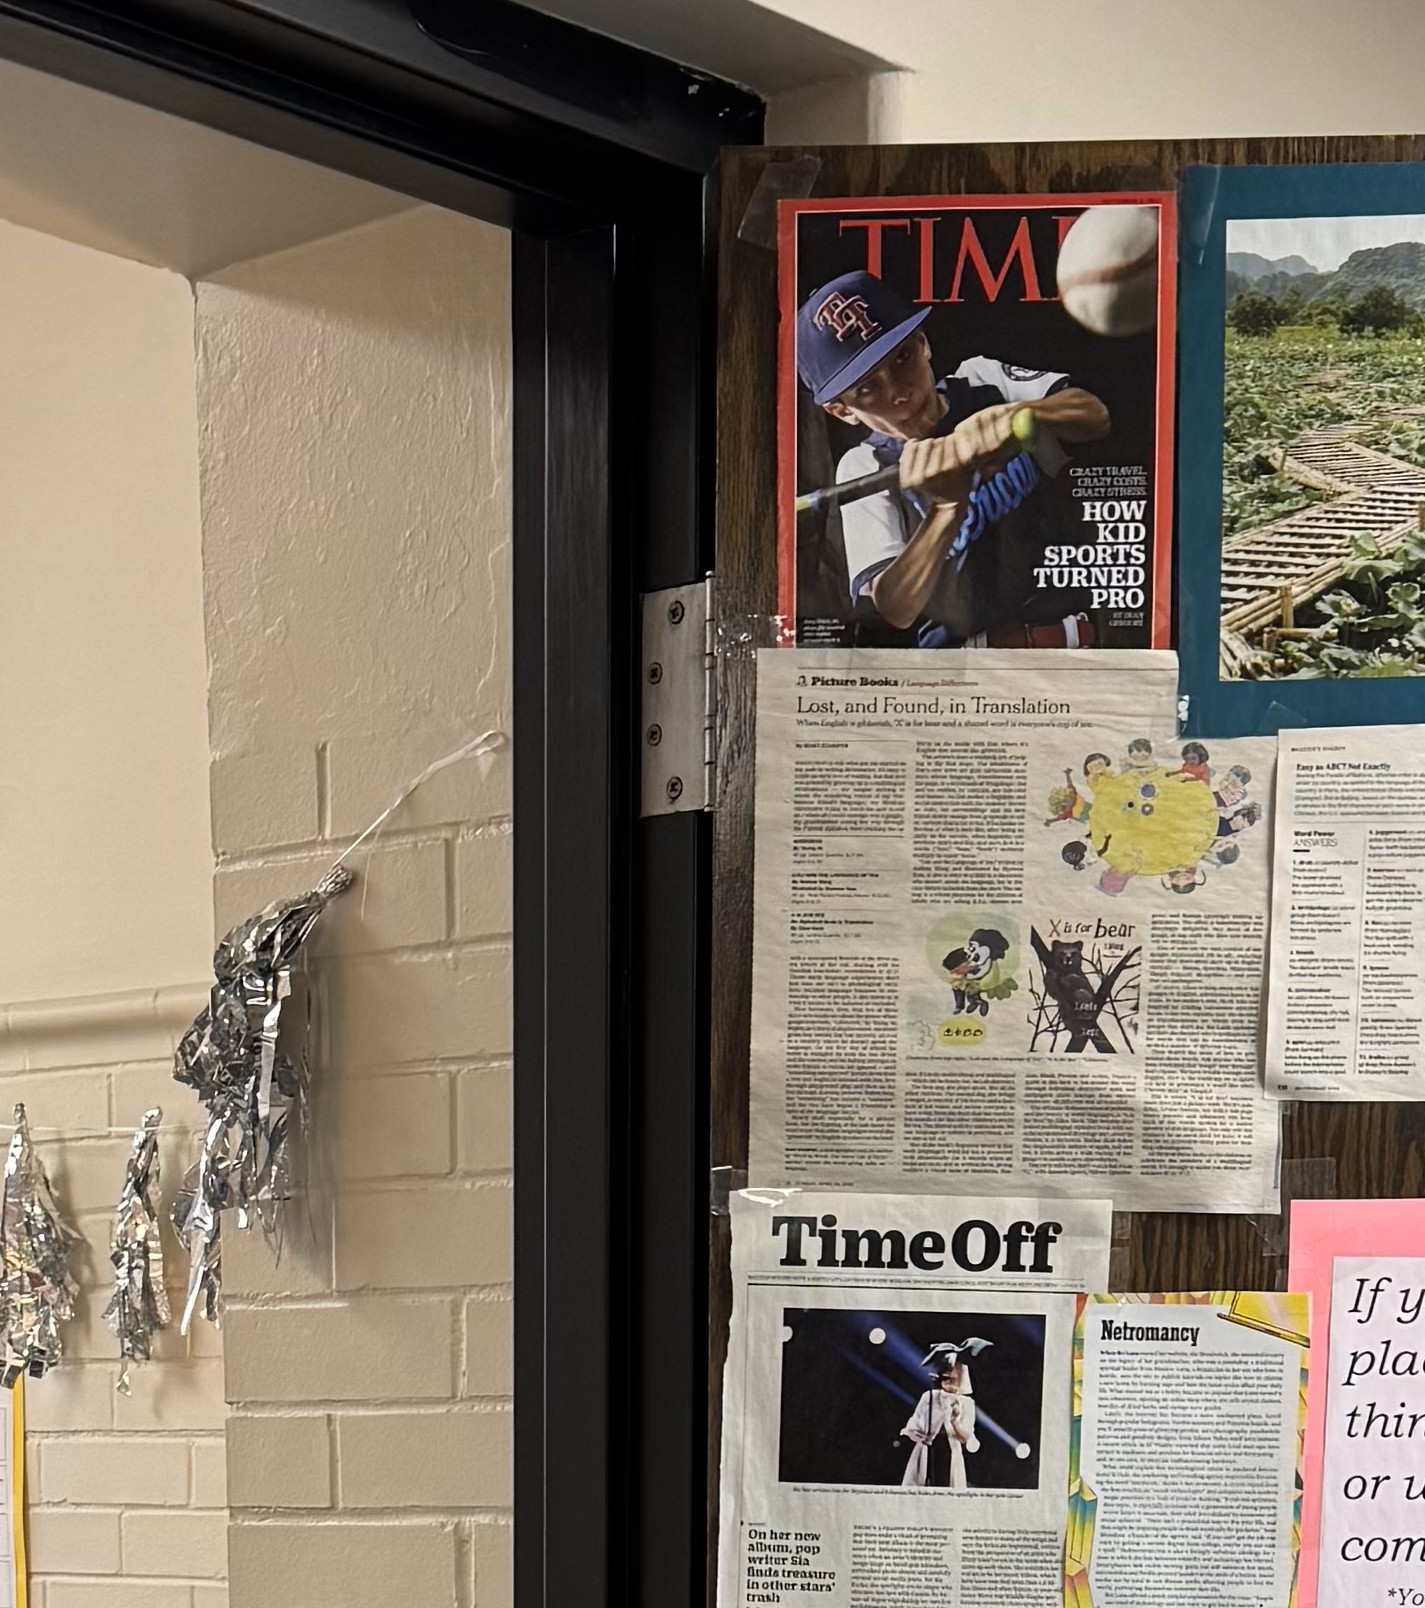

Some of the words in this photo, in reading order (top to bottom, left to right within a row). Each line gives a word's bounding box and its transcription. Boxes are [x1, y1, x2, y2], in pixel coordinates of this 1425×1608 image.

[839, 216, 1076, 303] TIM
[1082, 500, 1147, 521] HOW
[1096, 522, 1146, 543] KID
[1044, 544, 1146, 566] SPORTS
[1033, 566, 1145, 588] TURNED
[1090, 588, 1145, 609] PRO
[811, 677, 857, 686] Picture
[860, 677, 898, 687] Books
[797, 697, 840, 715] Lost,
[845, 697, 876, 714] and
[883, 697, 944, 715] Found,
[950, 698, 966, 714] in
[971, 697, 1070, 714] Translation
[1049, 919, 1061, 938] X
[1094, 918, 1136, 938] bear
[1348, 1276, 1392, 1324] If
[1100, 1321, 1200, 1346] Netromancy
[1343, 1472, 1391, 1501] or
